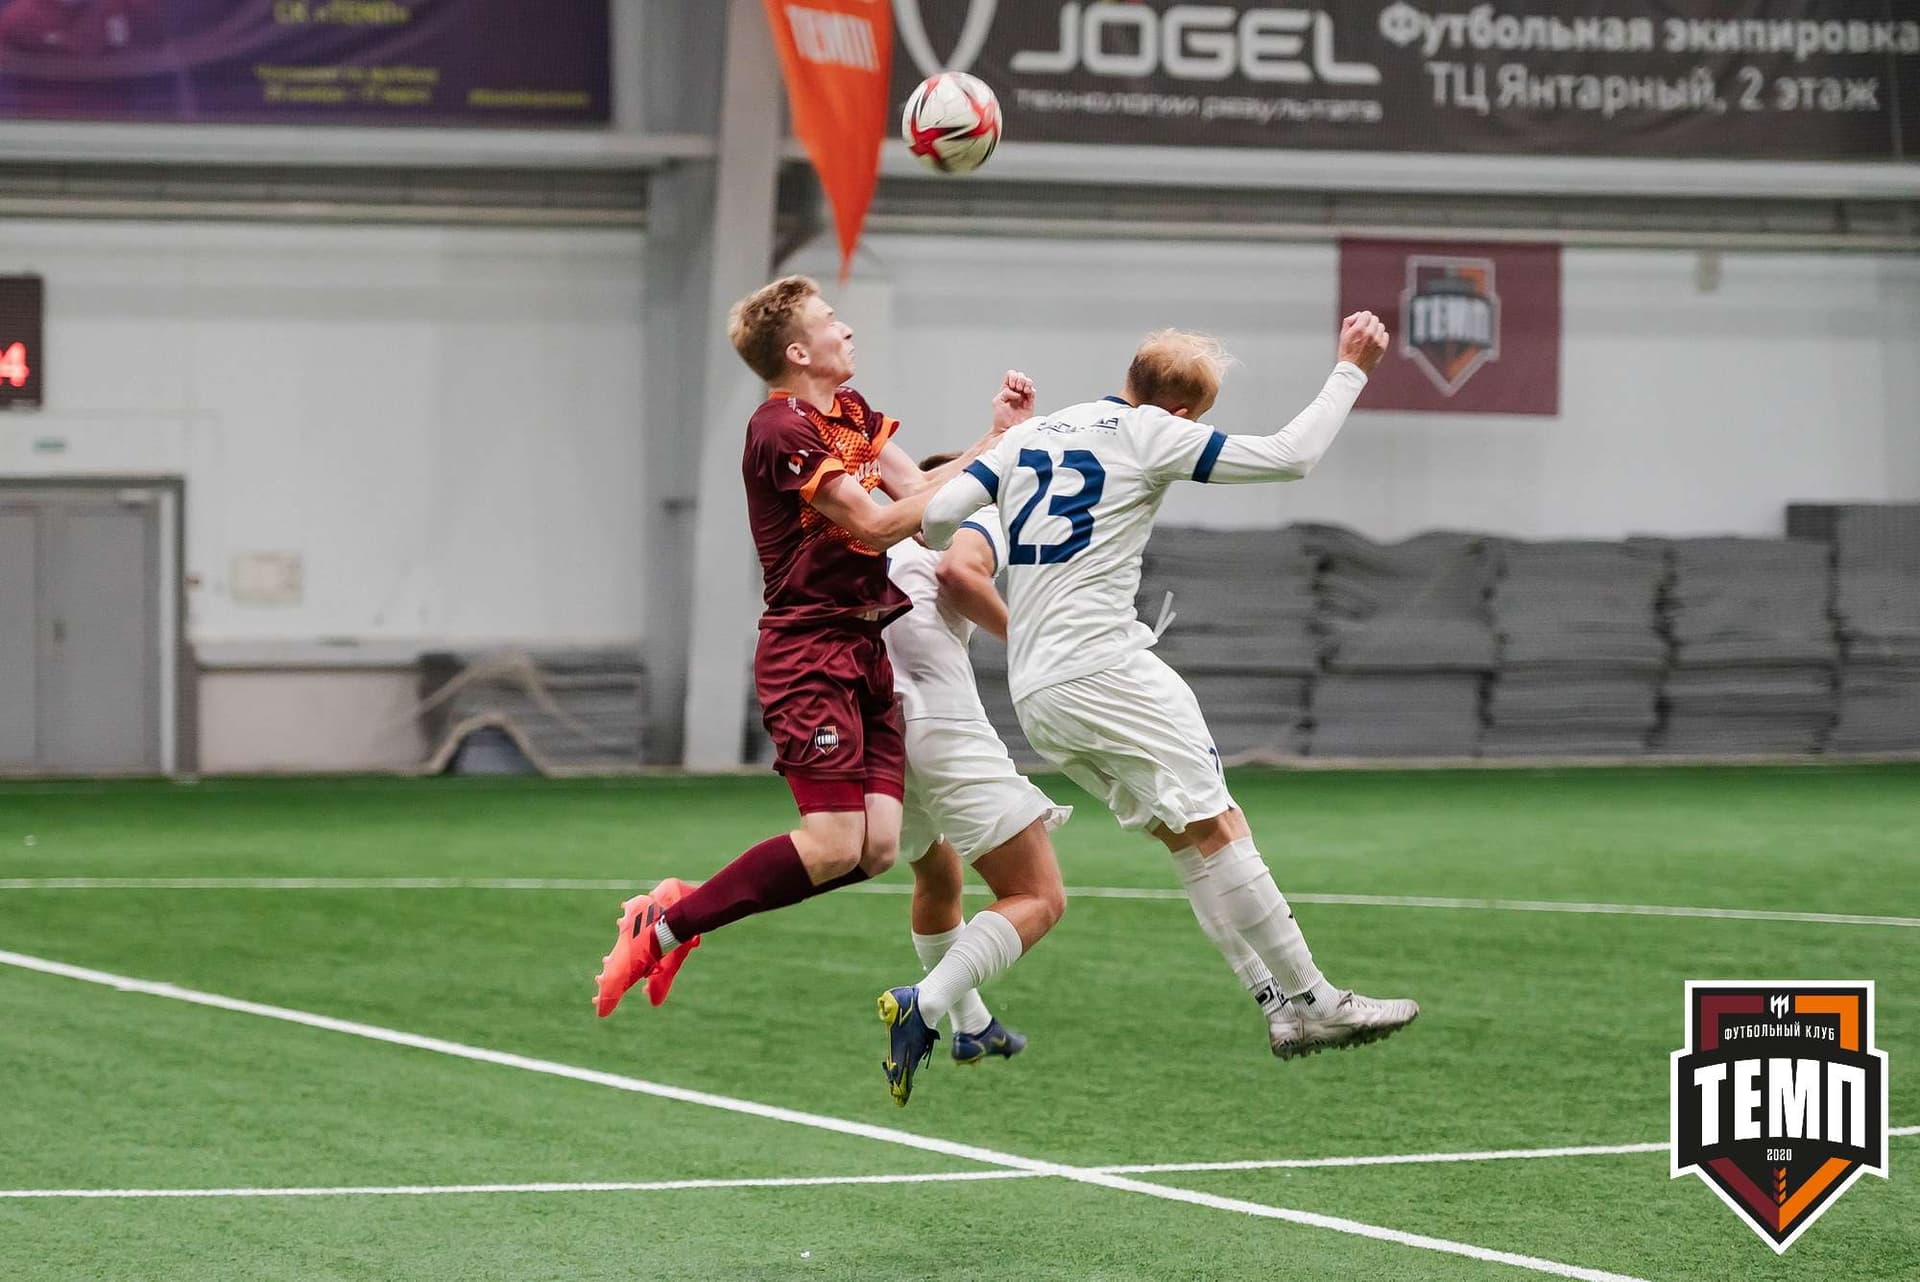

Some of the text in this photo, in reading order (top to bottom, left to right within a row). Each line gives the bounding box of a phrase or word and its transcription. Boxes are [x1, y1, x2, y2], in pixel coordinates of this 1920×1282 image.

[1380, 3, 1655, 56] Футбольная
[1426, 61, 1881, 119] ТЦ Янтарный, 2 этаж
[1008, 447, 1106, 565] 23
